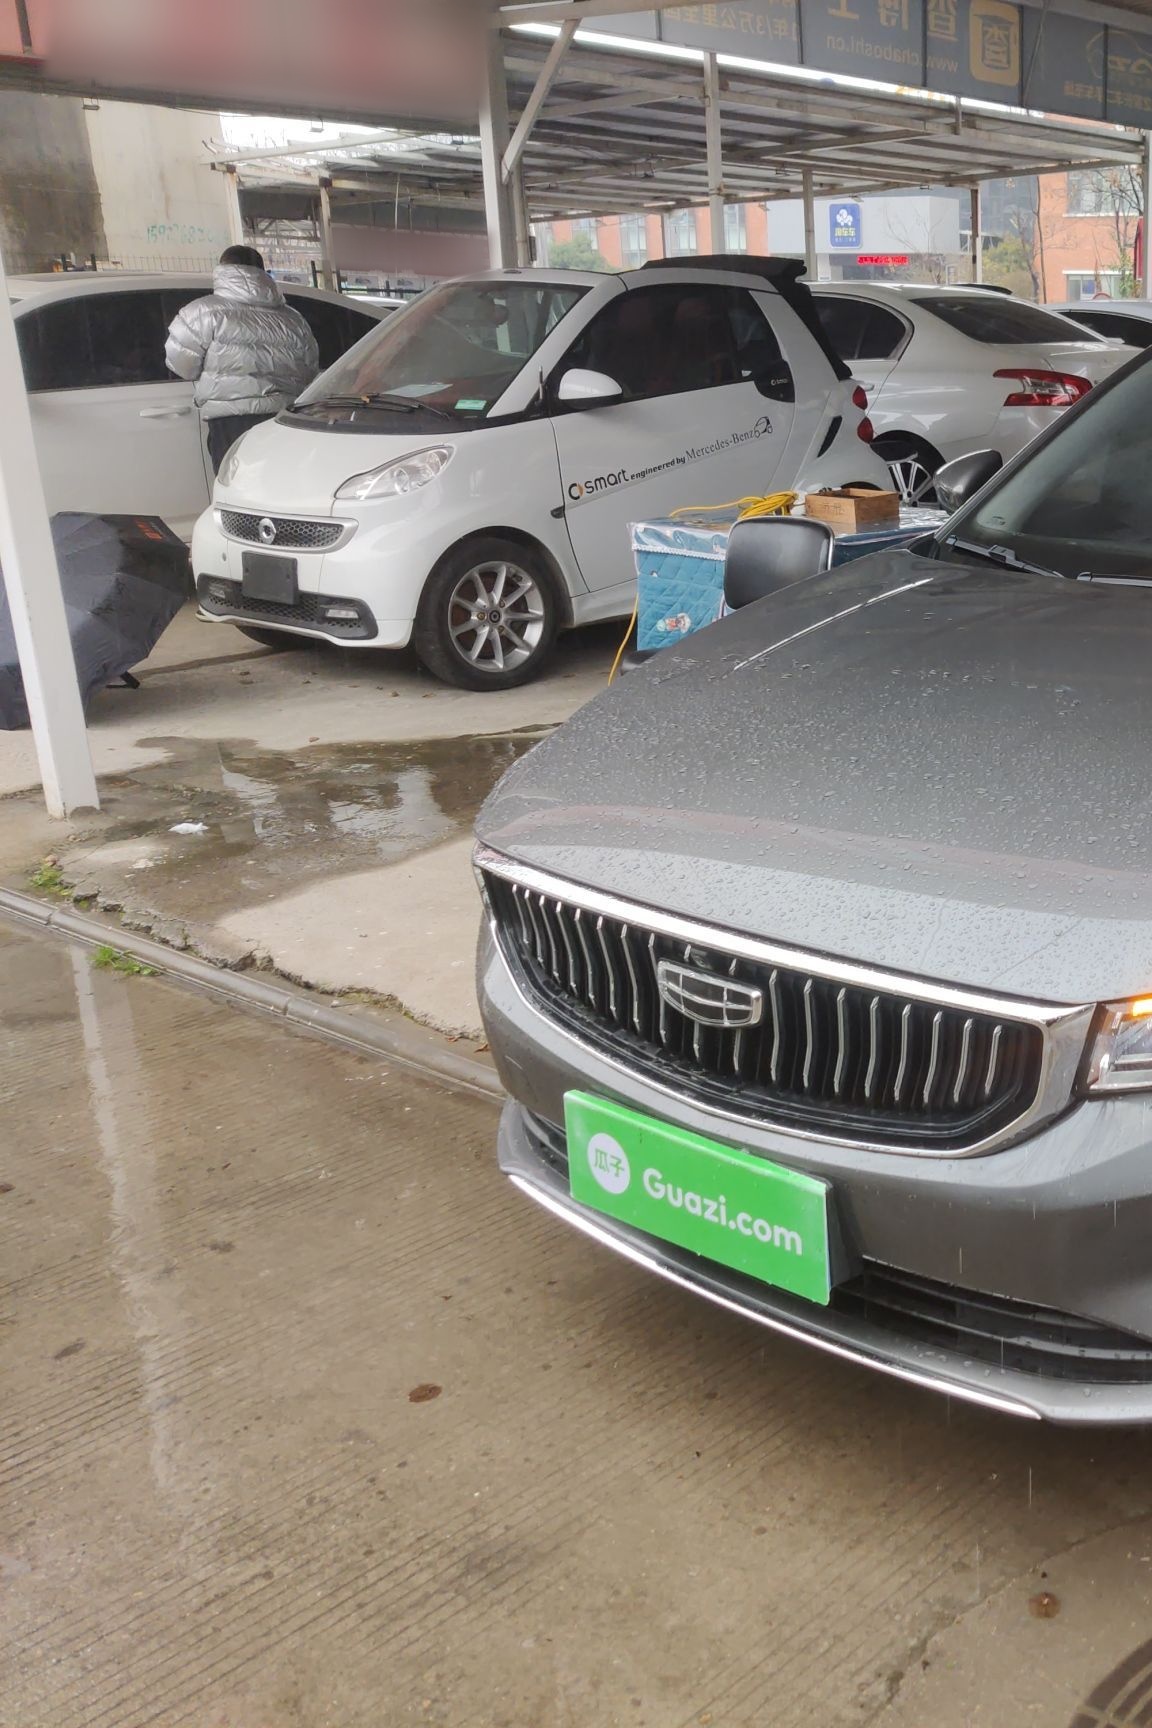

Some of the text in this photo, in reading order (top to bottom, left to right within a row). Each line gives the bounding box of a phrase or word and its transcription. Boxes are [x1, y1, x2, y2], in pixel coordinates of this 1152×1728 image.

[584, 429, 754, 494] smart engineered by Mercedes-Benz
[594, 1148, 625, 1177] 瓜子
[643, 1168, 803, 1256] Guazi.com
